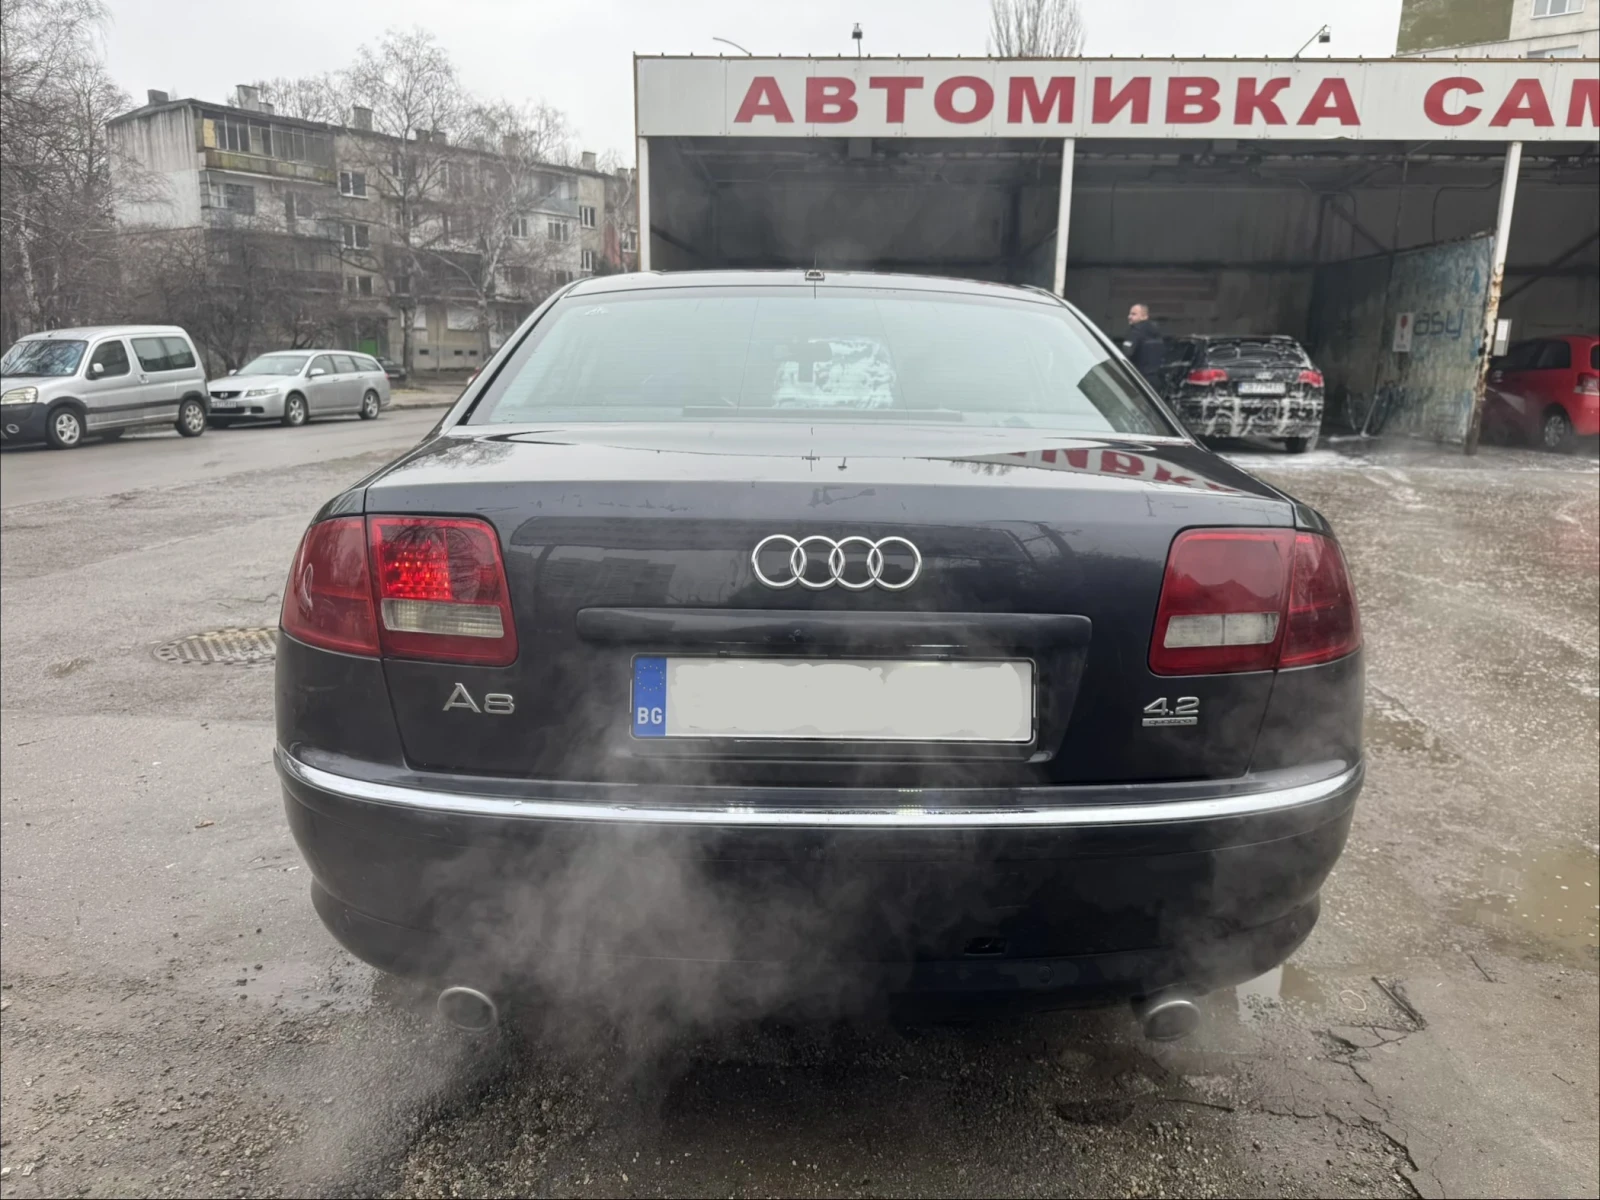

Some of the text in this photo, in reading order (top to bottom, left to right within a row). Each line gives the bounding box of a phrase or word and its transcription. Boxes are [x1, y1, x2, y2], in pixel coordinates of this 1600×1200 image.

[733, 75, 1361, 126] АВТОМИВКА
[442, 682, 515, 715] A8
[1143, 696, 1200, 716] 4.2
[637, 706, 663, 725] BG
